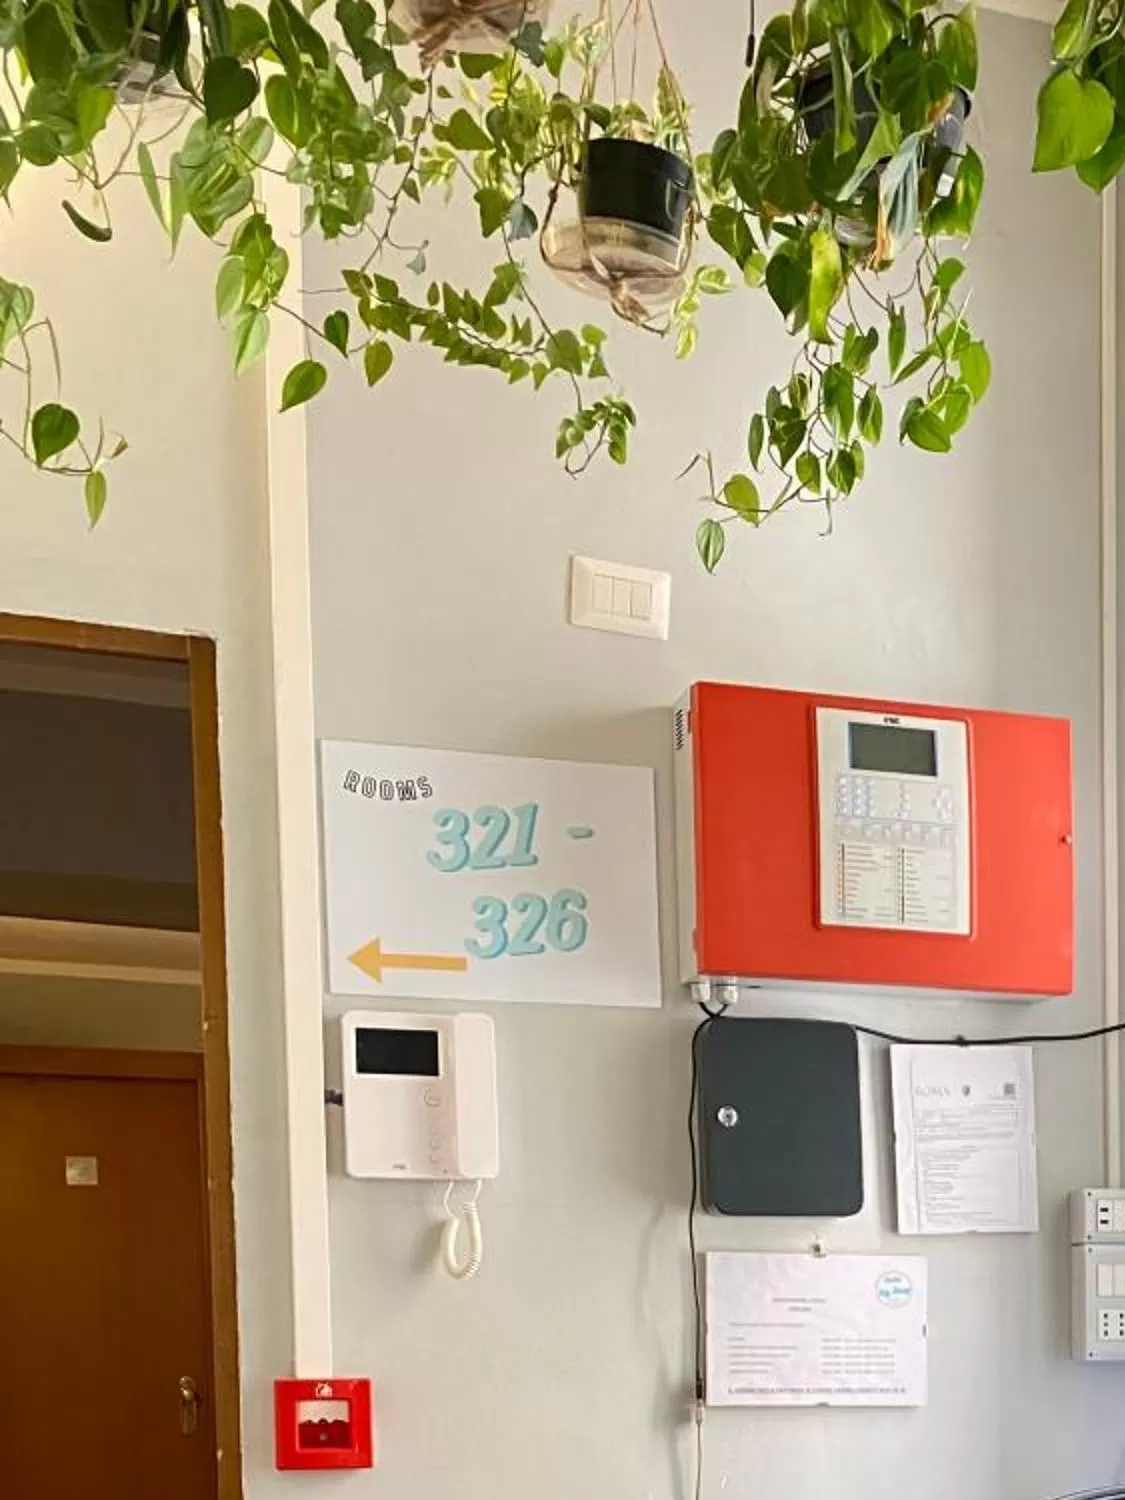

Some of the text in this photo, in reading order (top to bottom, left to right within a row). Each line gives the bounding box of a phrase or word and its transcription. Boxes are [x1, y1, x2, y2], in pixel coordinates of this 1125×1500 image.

[343, 769, 433, 801] ROOMS
[426, 802, 539, 873] 321
[464, 888, 589, 958] 326
